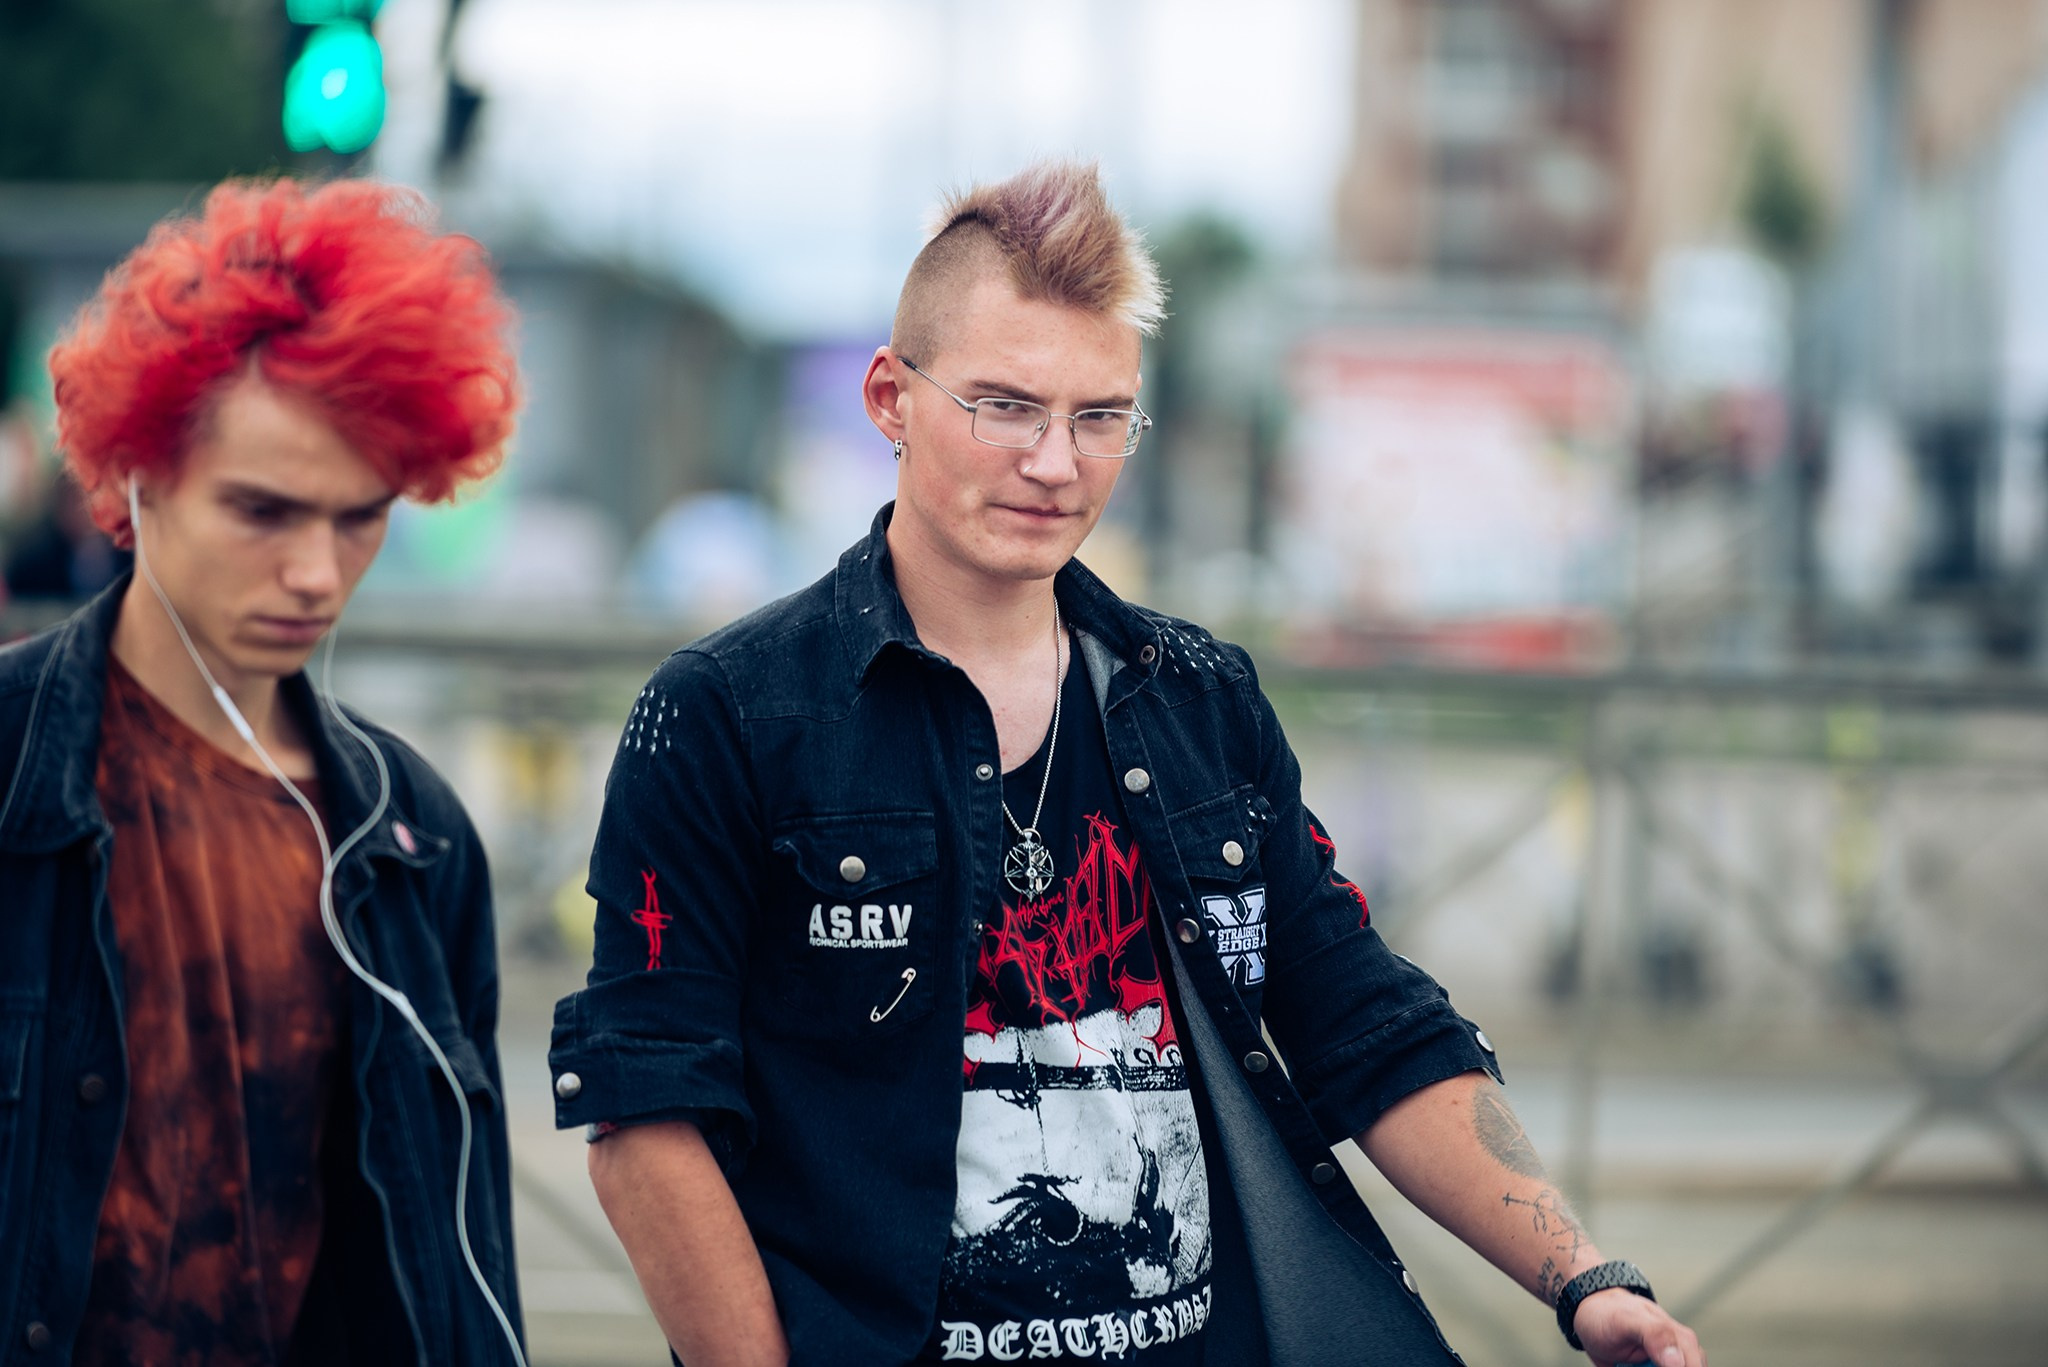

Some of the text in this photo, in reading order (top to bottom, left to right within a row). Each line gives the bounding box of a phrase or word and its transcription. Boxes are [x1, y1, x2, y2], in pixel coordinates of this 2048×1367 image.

[809, 903, 913, 939] ASRV
[1217, 924, 1260, 941] STRAIGHT
[850, 938, 909, 950] SPORTSWEAR
[1217, 937, 1260, 953] EDGE
